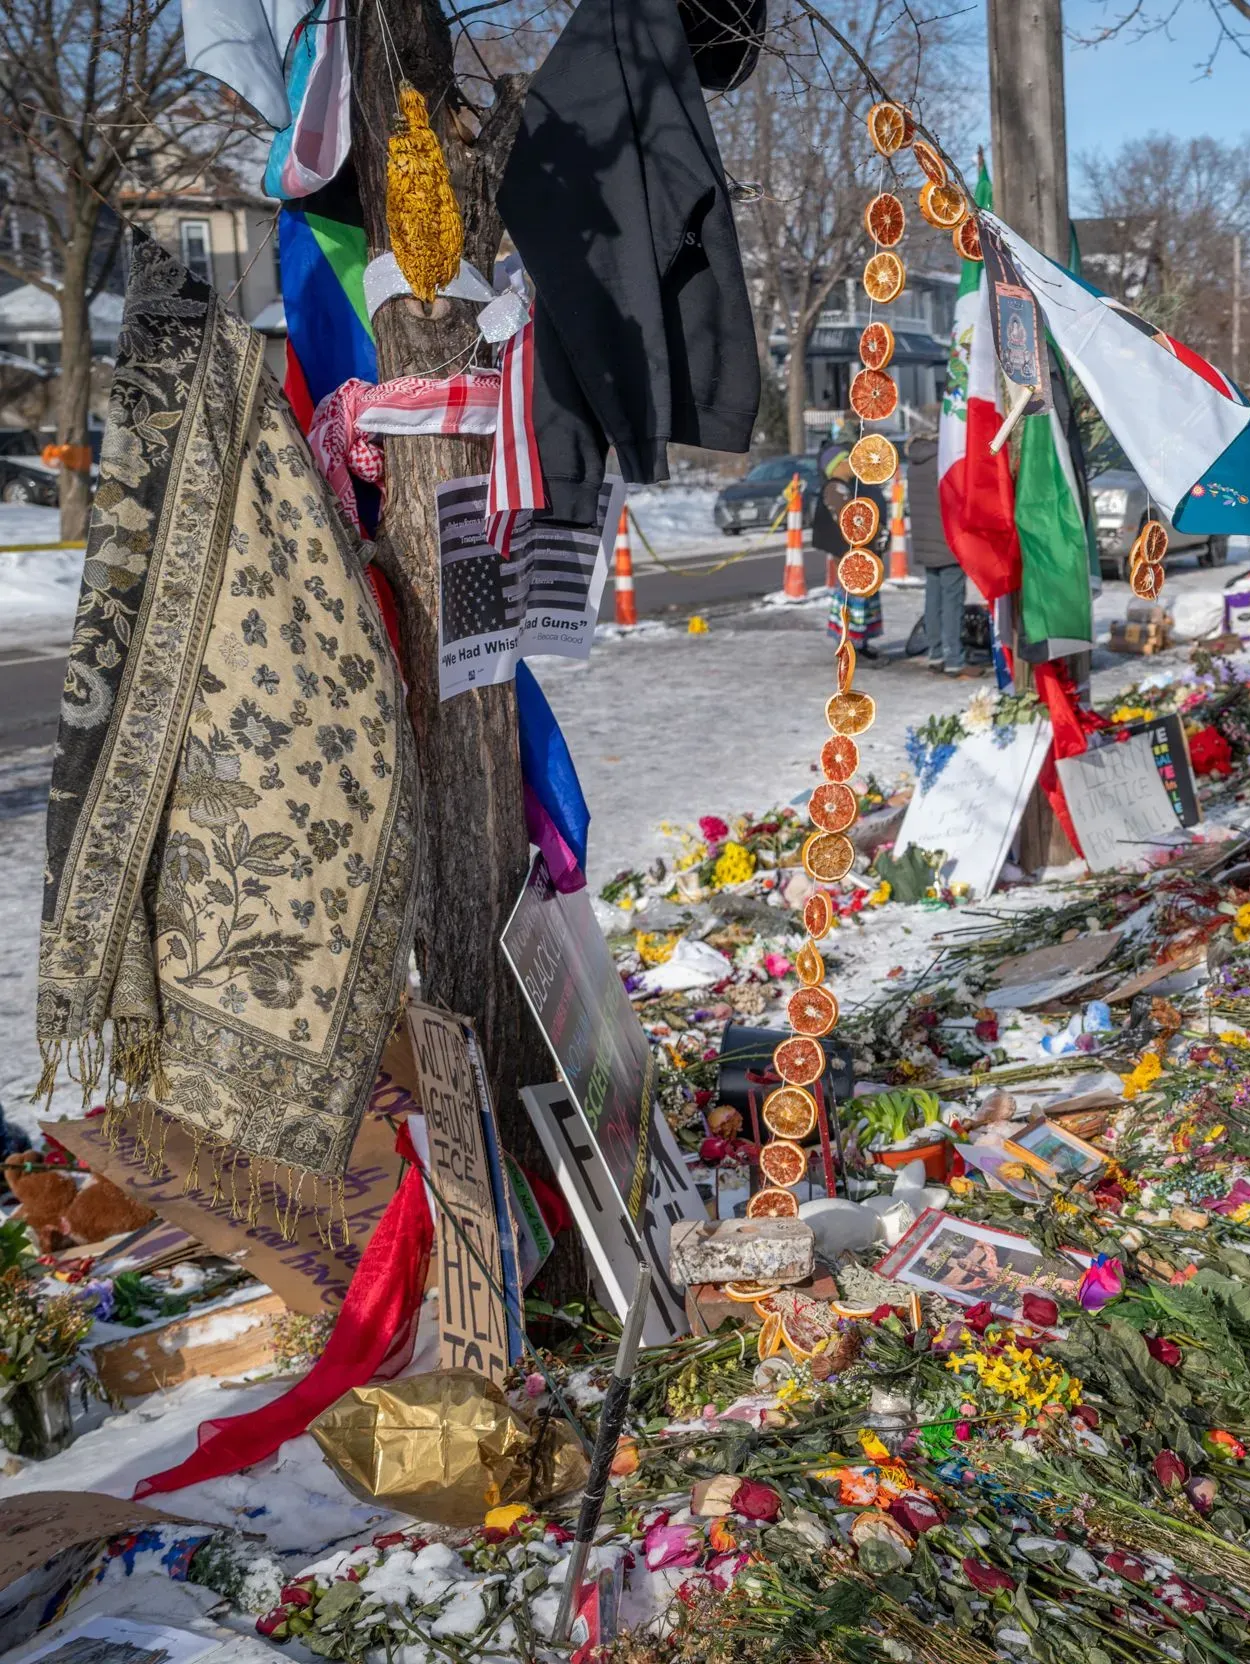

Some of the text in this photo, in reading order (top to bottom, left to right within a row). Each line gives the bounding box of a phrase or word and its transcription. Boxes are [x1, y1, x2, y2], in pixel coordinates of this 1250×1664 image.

[458, 644, 481, 662] Had
[560, 633, 584, 645] Good
[1084, 776, 1153, 819] JUSTICE
[1086, 826, 1118, 861] FOR
[524, 929, 558, 1015] BLACK
[583, 1016, 614, 1134] SCIENCE
[434, 1138, 478, 1185] ICE
[441, 1212, 504, 1348] HEX
